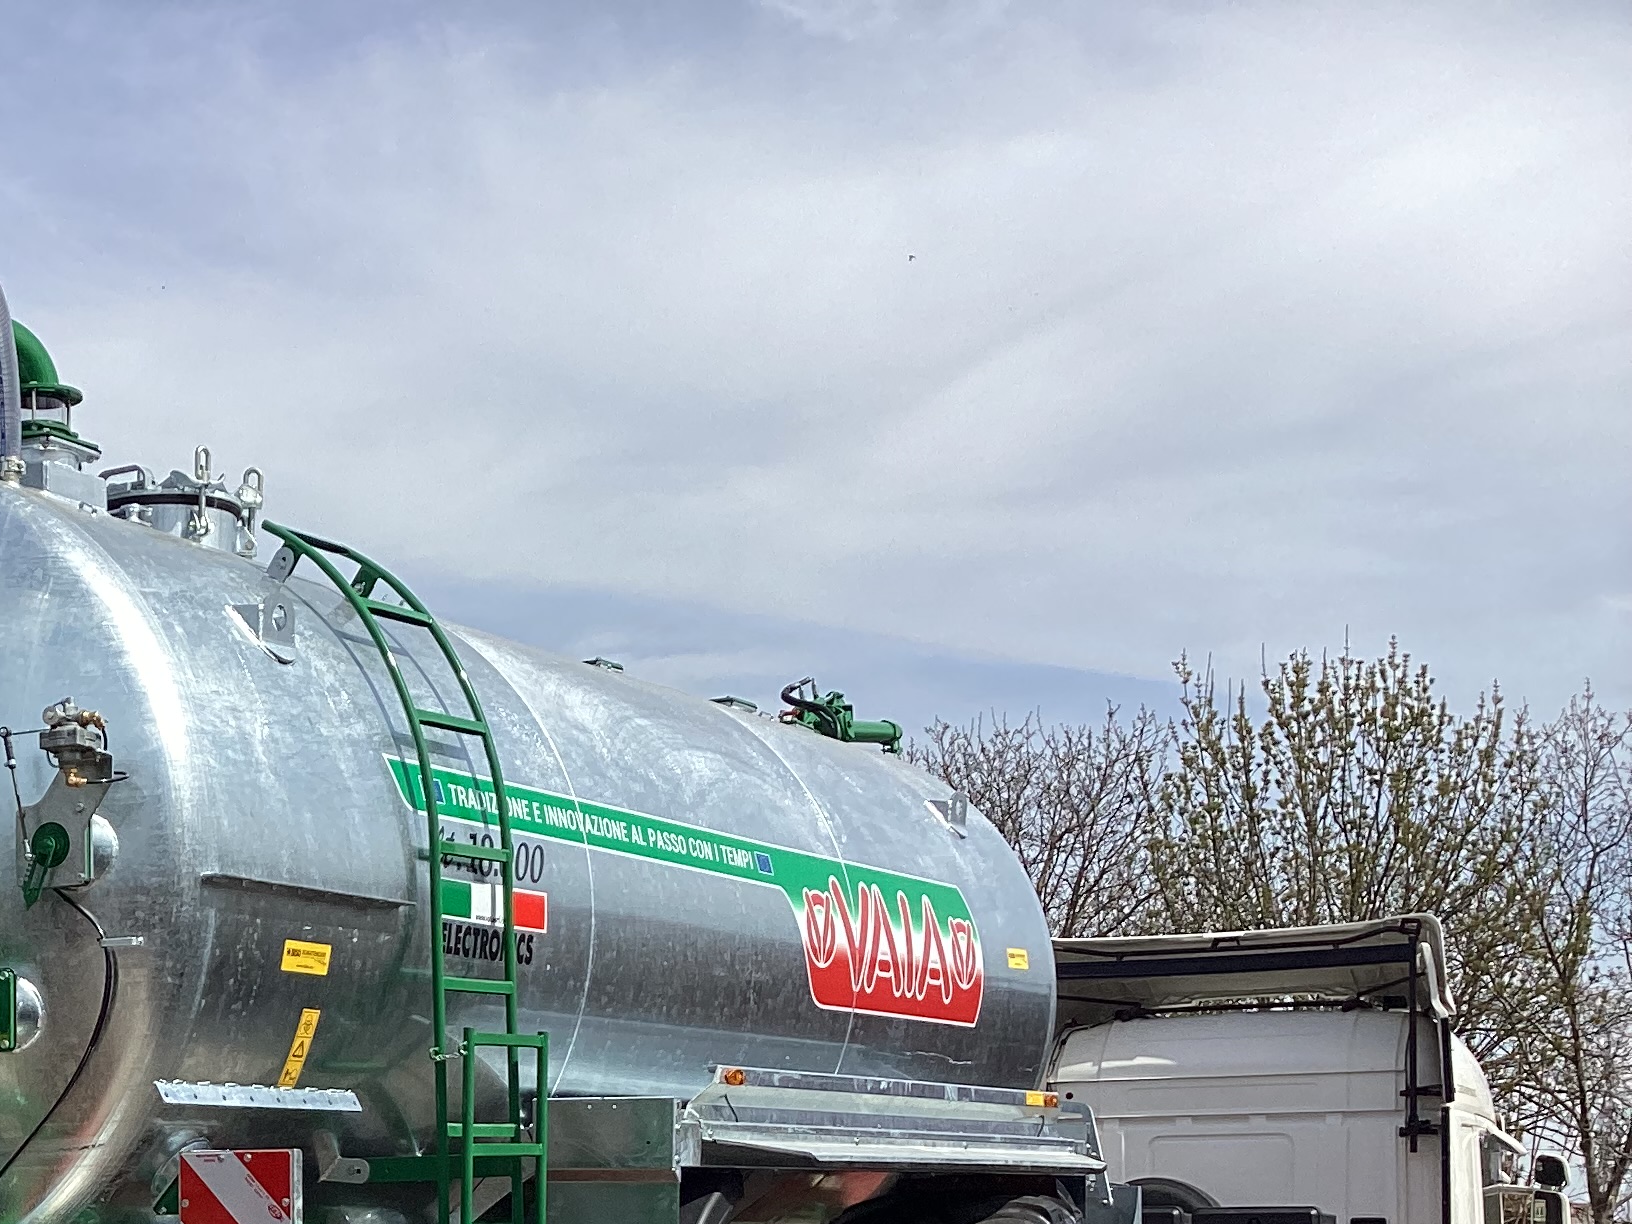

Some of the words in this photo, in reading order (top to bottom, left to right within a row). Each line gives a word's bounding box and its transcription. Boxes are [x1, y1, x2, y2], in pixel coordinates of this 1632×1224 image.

[447, 783, 531, 821] TRADIZONE
[533, 803, 542, 823] E
[543, 803, 629, 842] INNOVAZIONE
[631, 824, 647, 846] AL
[648, 828, 687, 855] PASSO
[688, 838, 713, 861] CON
[714, 843, 719, 862] I
[720, 844, 754, 870] TEMPI
[442, 922, 534, 966] ELECTROCS
[828, 875, 953, 1005] VAIA
